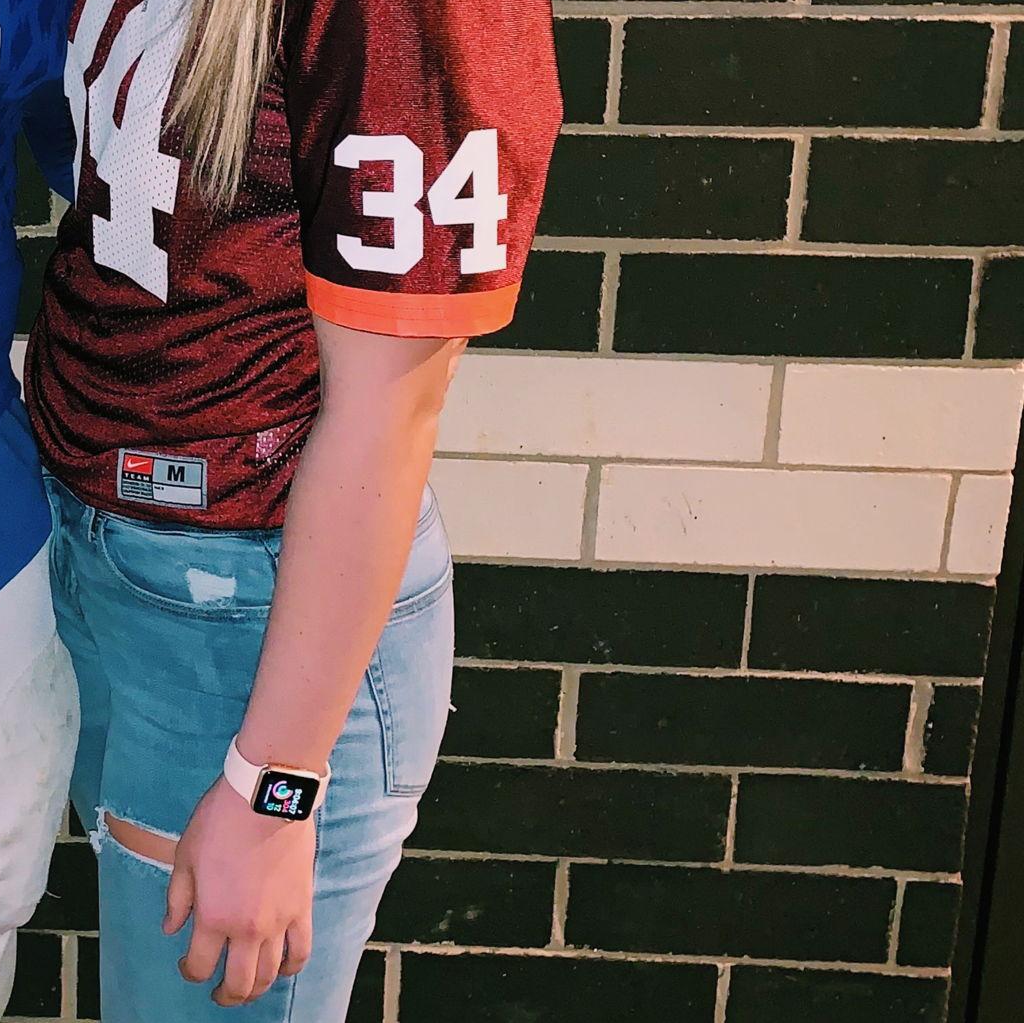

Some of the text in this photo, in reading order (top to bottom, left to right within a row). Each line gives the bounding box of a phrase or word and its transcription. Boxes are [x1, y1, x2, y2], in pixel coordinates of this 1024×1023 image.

[333, 128, 508, 275] 34
[125, 473, 150, 482] TEAM
[167, 465, 185, 482] M
